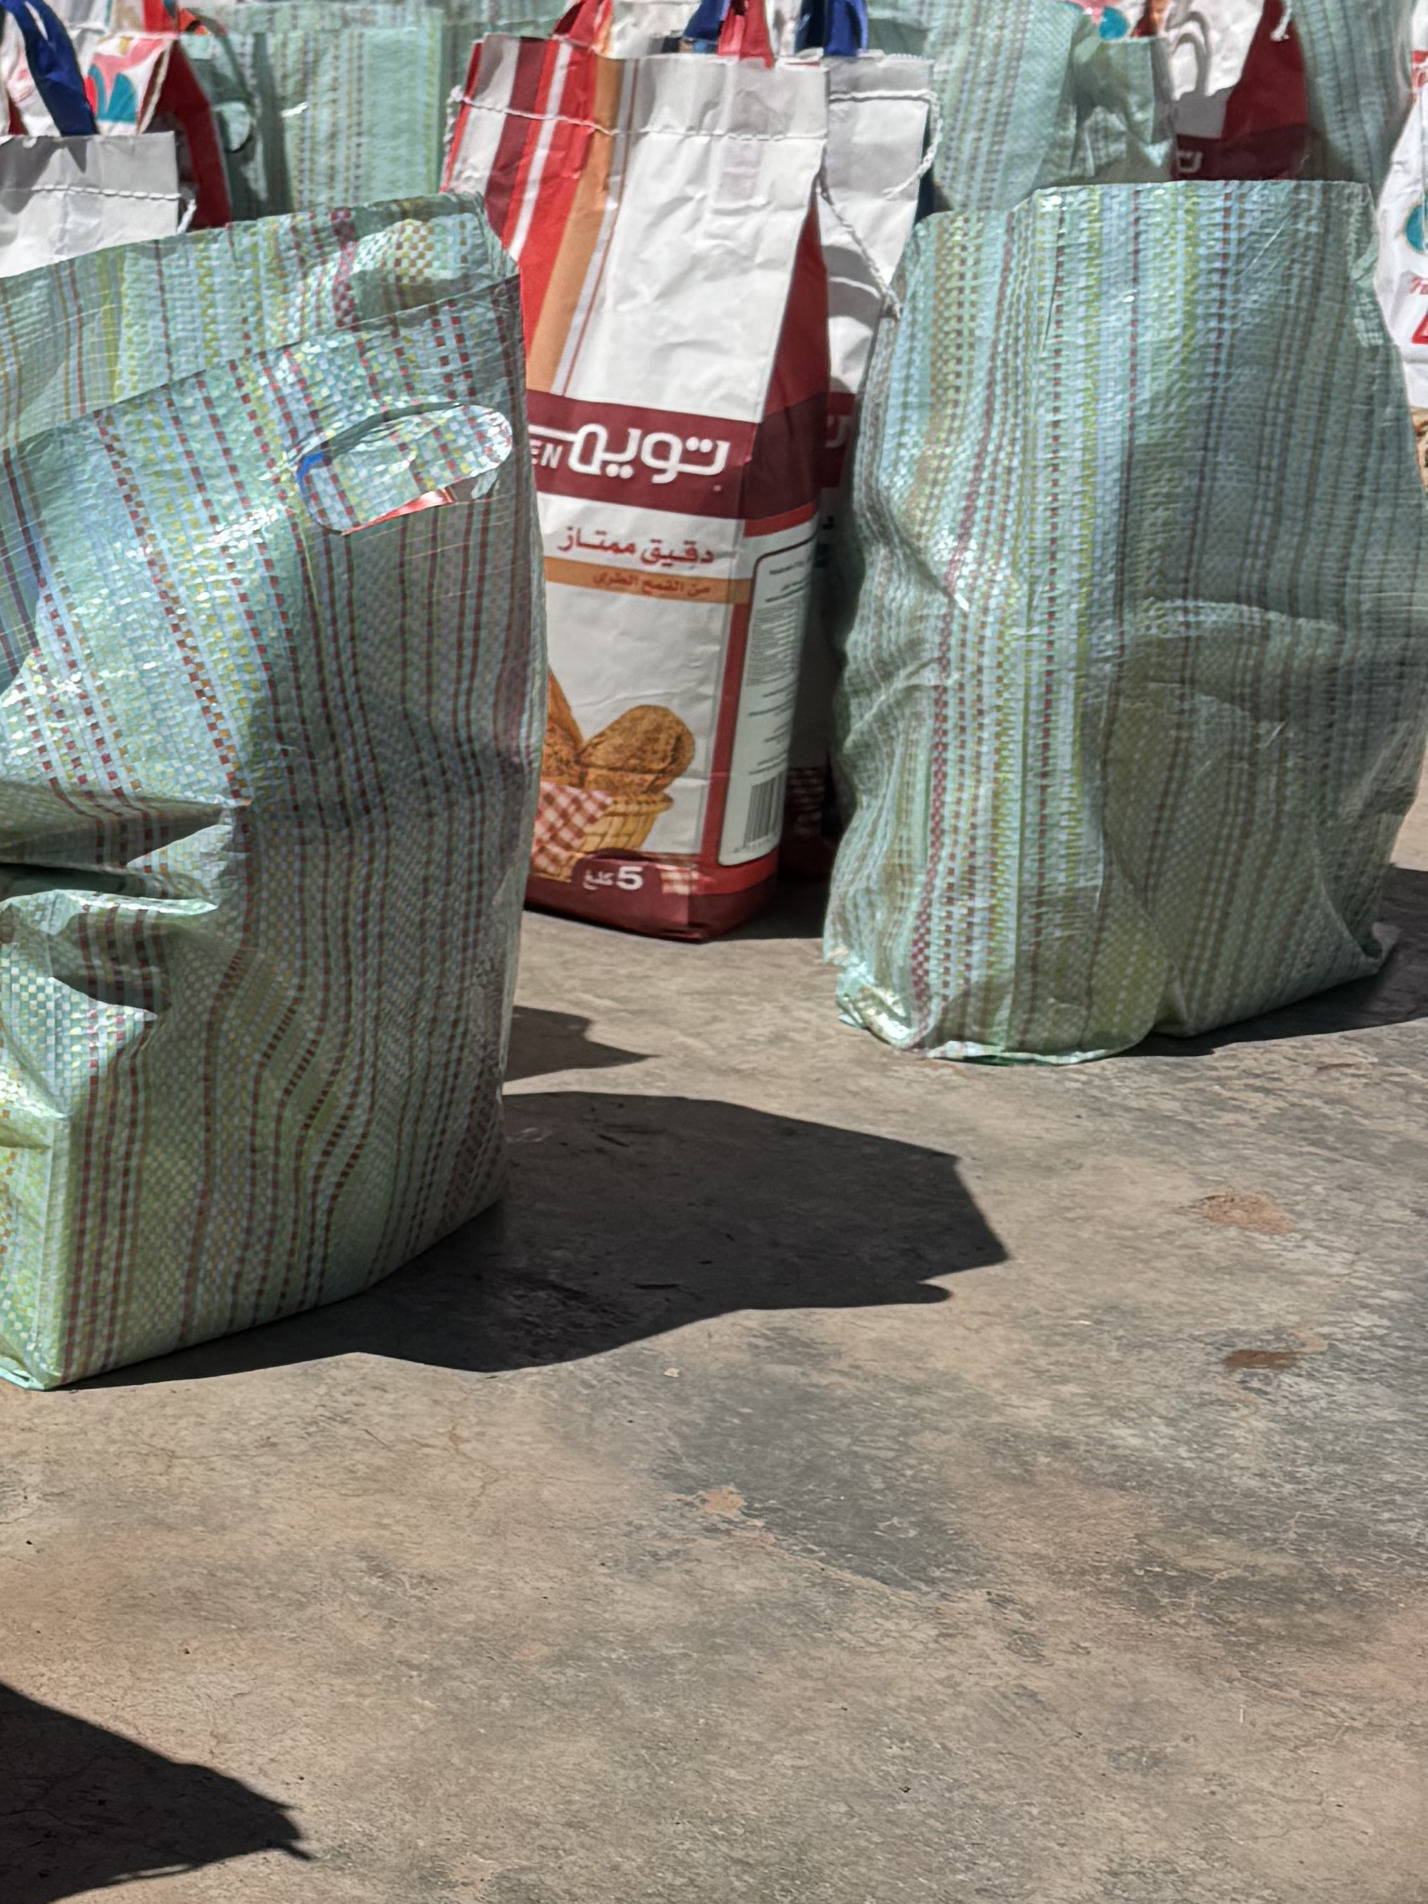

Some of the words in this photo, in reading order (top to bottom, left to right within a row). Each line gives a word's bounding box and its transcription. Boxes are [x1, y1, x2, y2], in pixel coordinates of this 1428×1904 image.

[556, 524, 634, 558] ممتاز
[639, 538, 717, 566] دقيق
[618, 867, 644, 892] 5
